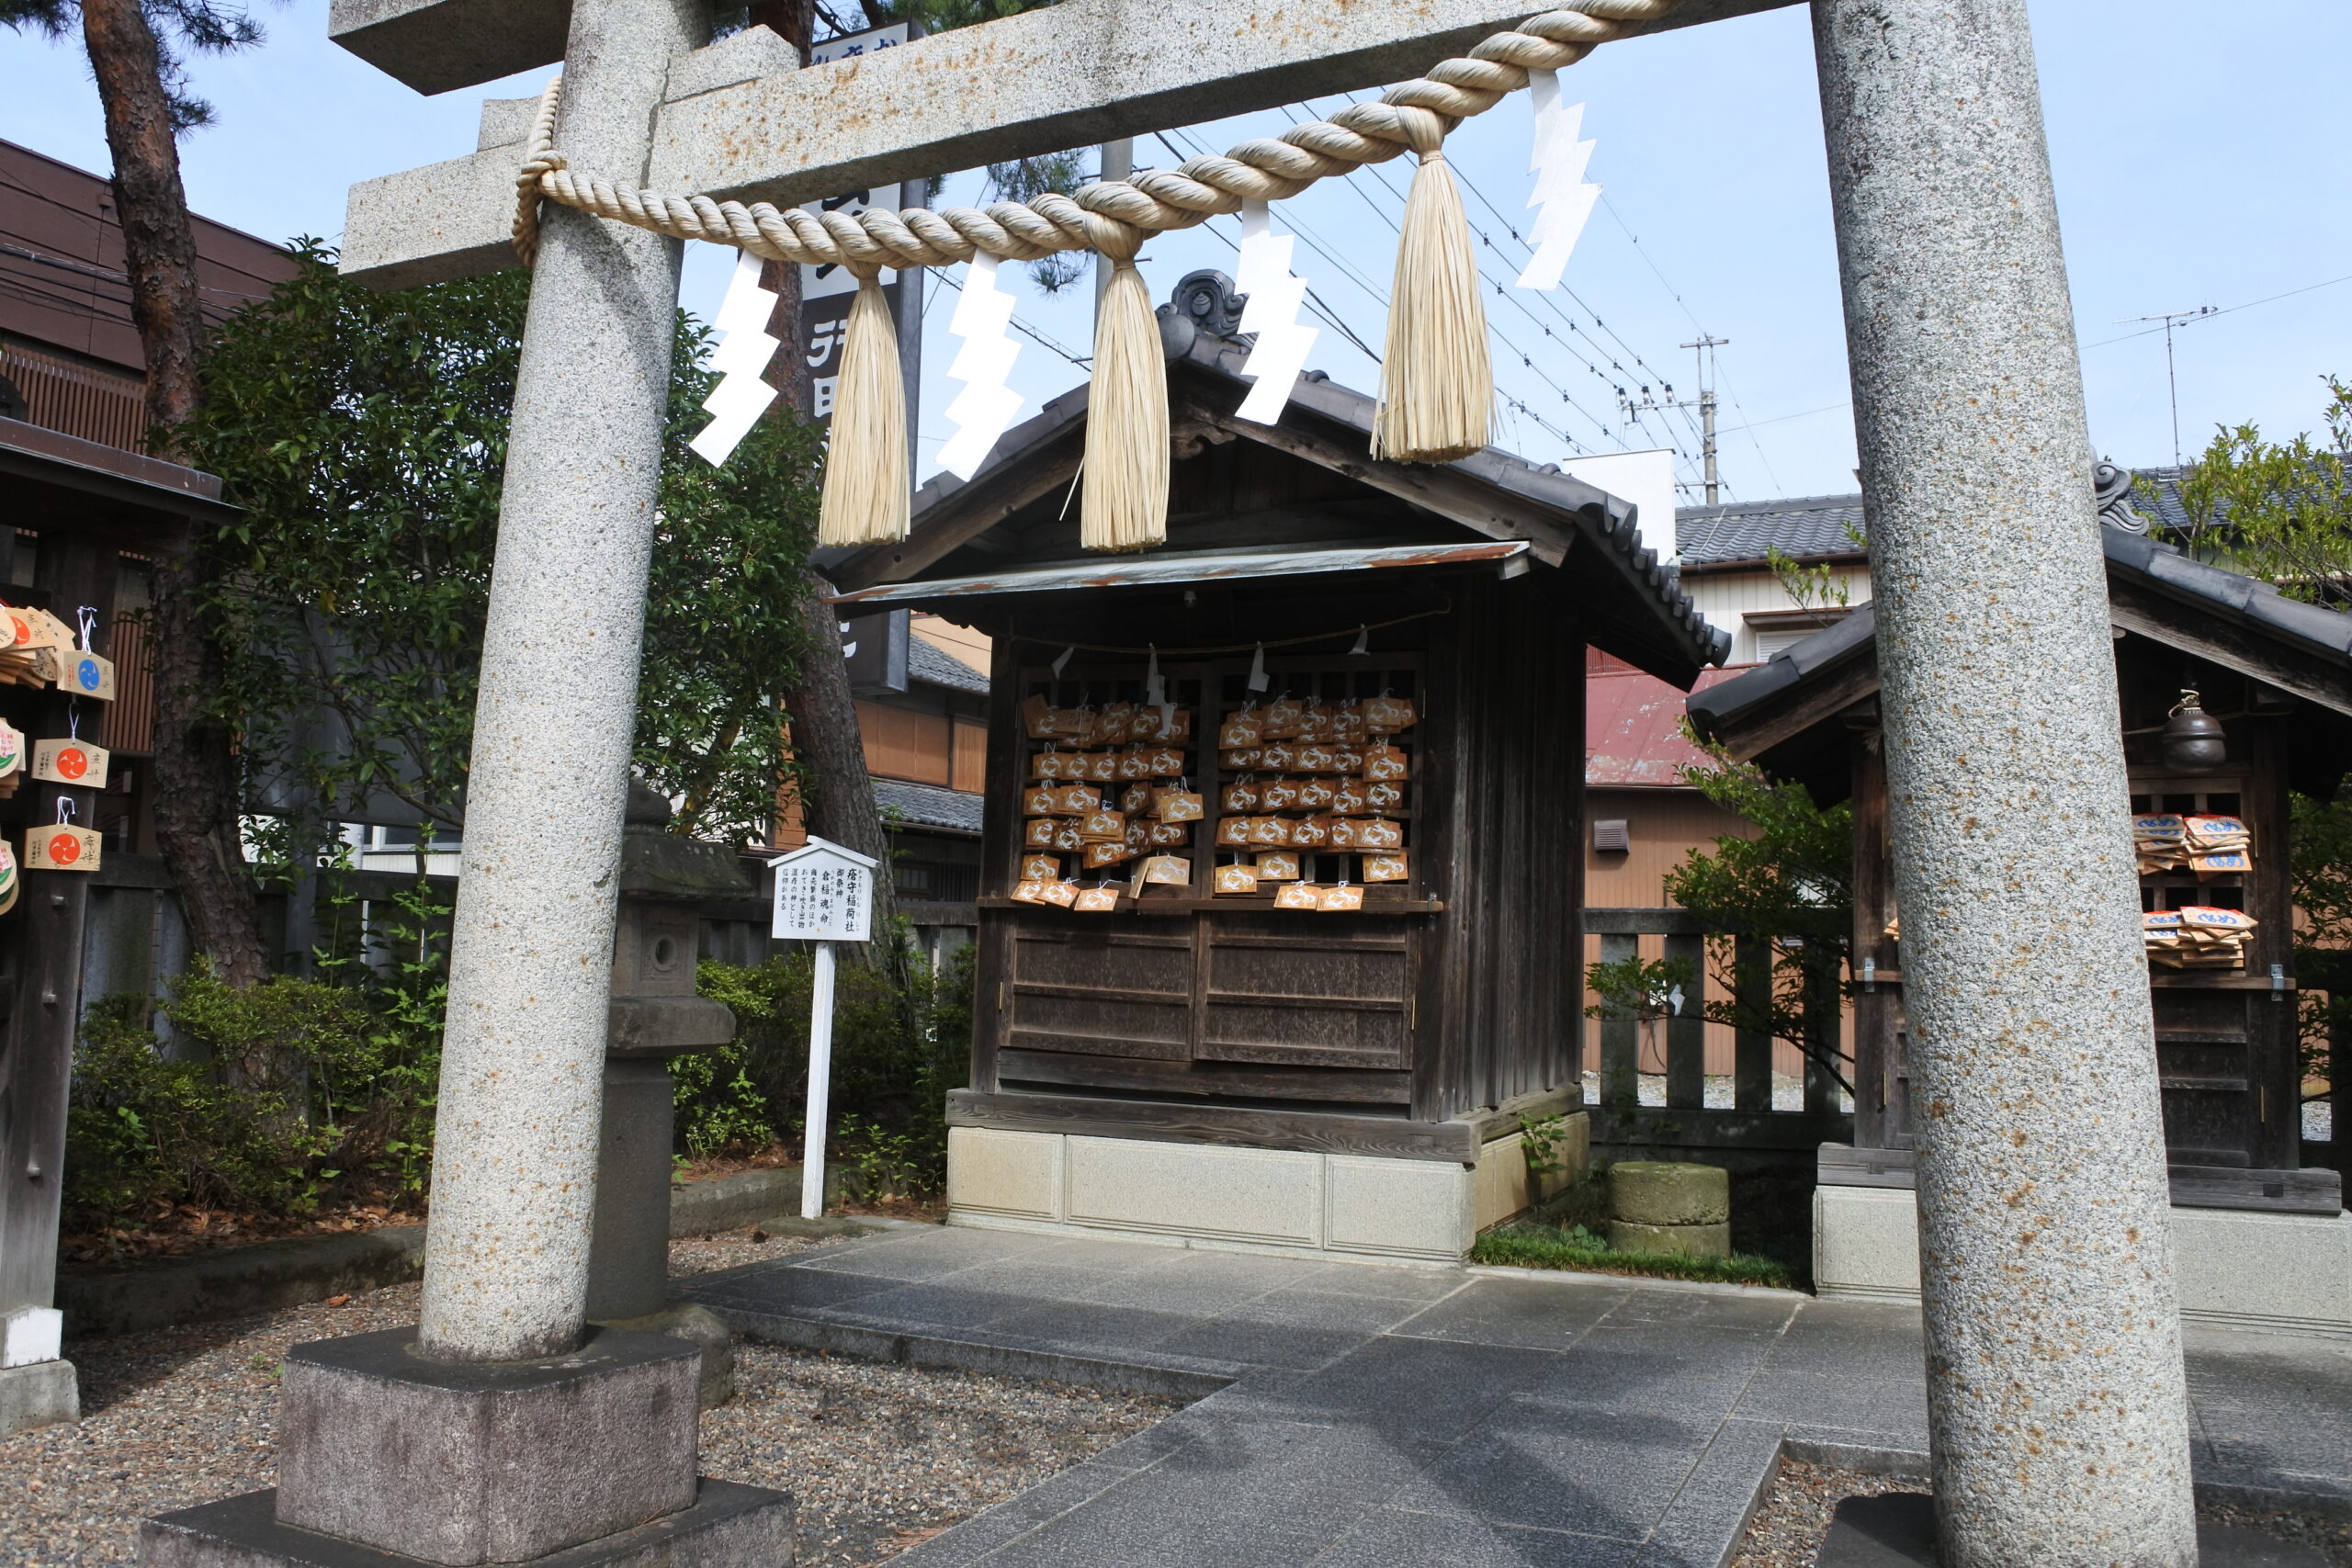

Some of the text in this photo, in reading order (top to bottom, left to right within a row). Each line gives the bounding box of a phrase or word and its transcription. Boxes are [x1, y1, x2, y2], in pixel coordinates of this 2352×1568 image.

[820, 871, 830, 924] 倉稲魂命
[836, 868, 844, 898] 御祭神
[845, 868, 857, 932] 瘡守稲荷社
